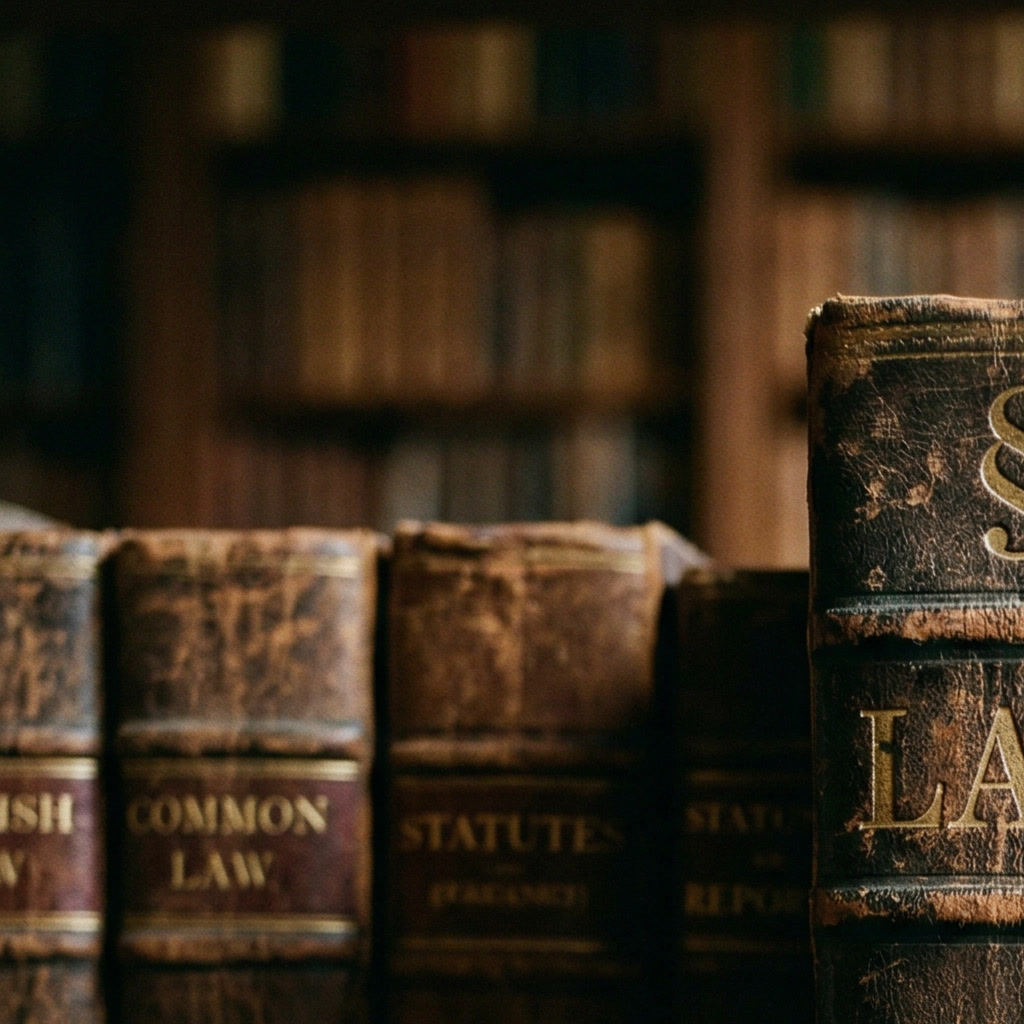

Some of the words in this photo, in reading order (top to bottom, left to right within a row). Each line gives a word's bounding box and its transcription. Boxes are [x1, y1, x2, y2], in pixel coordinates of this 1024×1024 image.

[125, 795, 329, 835] COMMON
[399, 812, 627, 854] STATUTES
[171, 849, 273, 891] LAW
